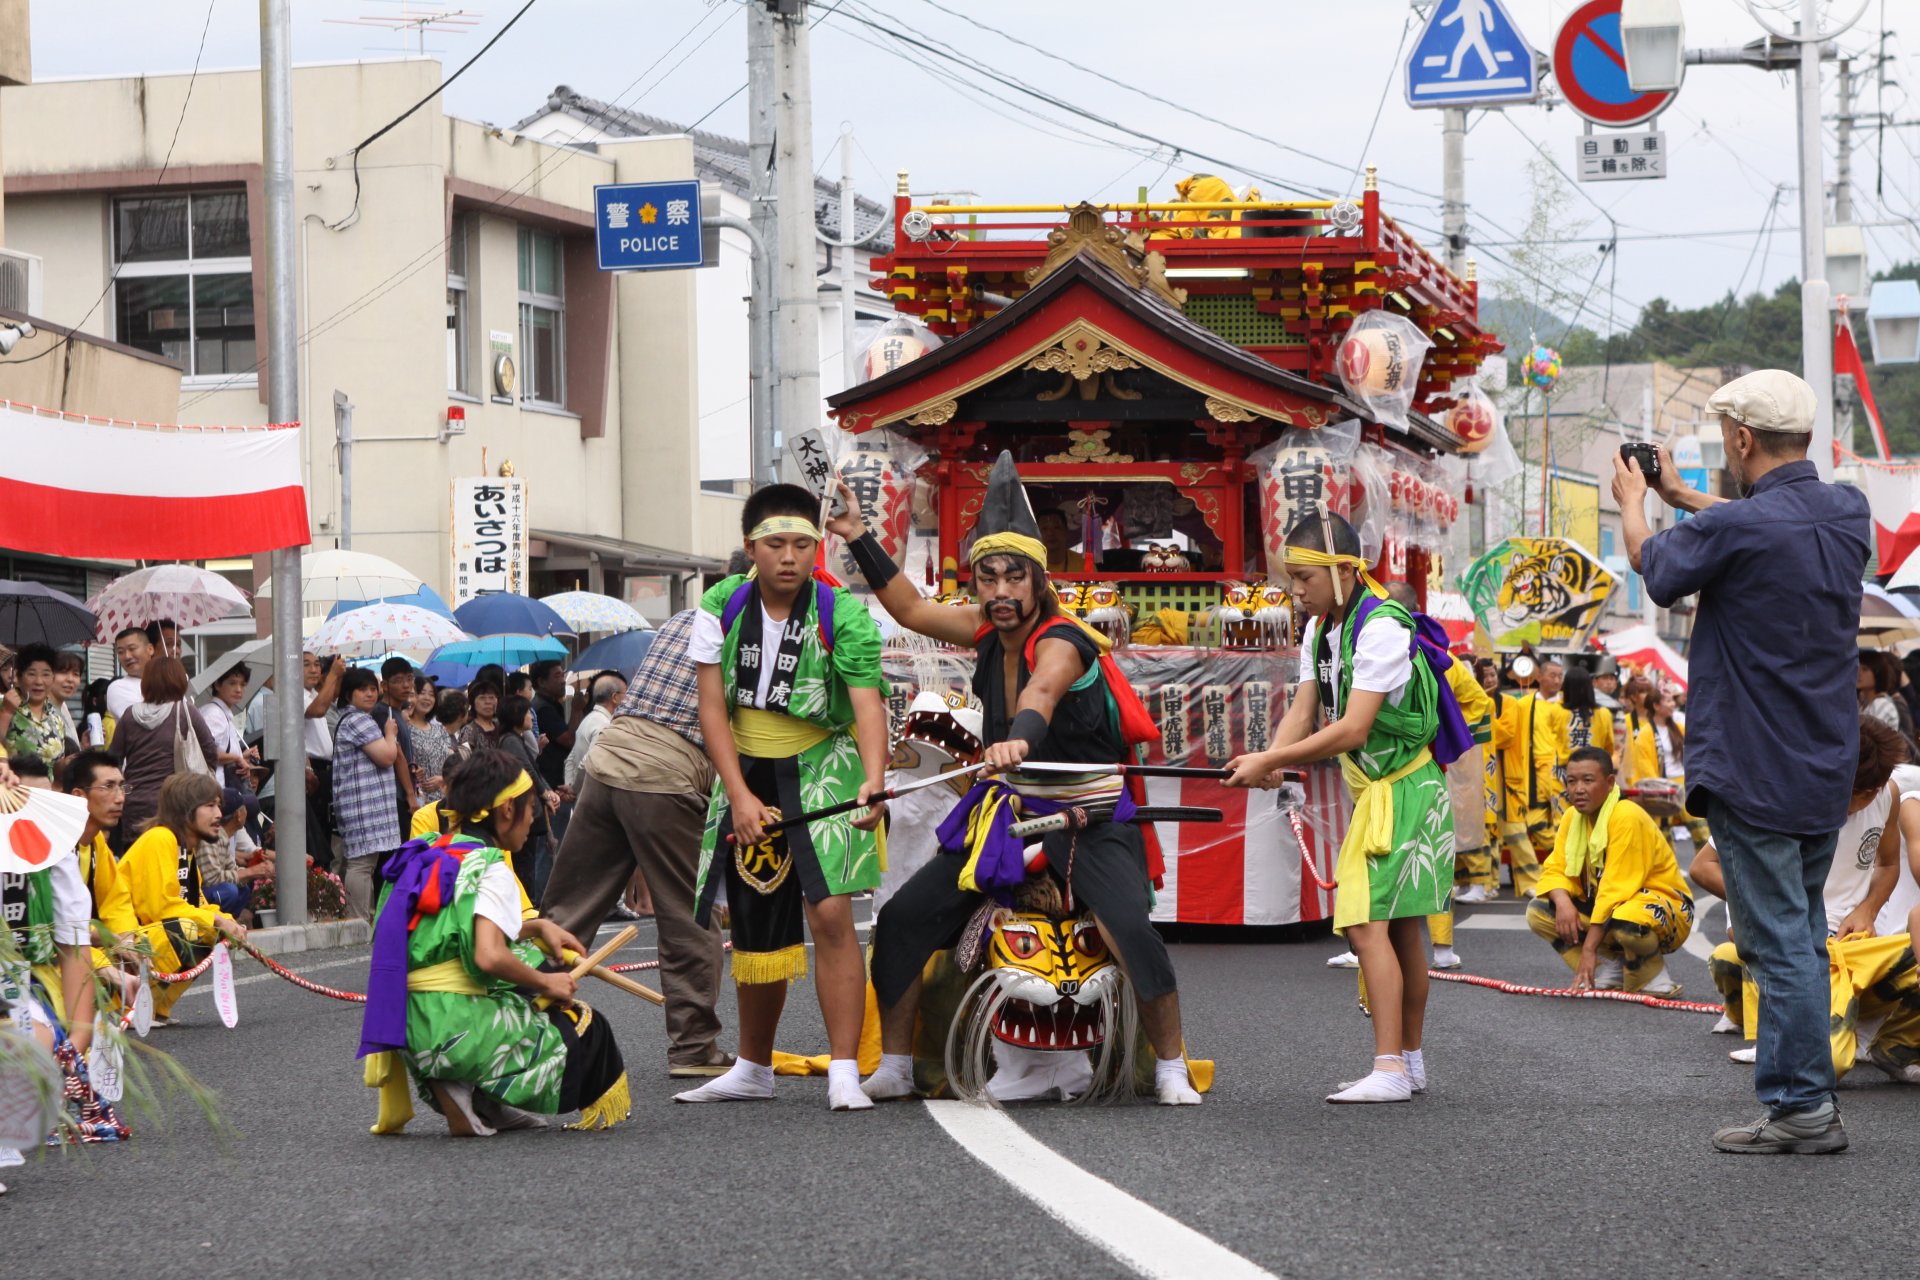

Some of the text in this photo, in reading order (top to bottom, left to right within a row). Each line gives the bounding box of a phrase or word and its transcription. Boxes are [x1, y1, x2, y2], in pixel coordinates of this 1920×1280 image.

[1584, 137, 1658, 155] 自動車
[1584, 157, 1659, 174] 二輪を除く
[606, 199, 689, 228] 警察
[620, 236, 679, 253] POLICE
[799, 436, 840, 510] 大神
